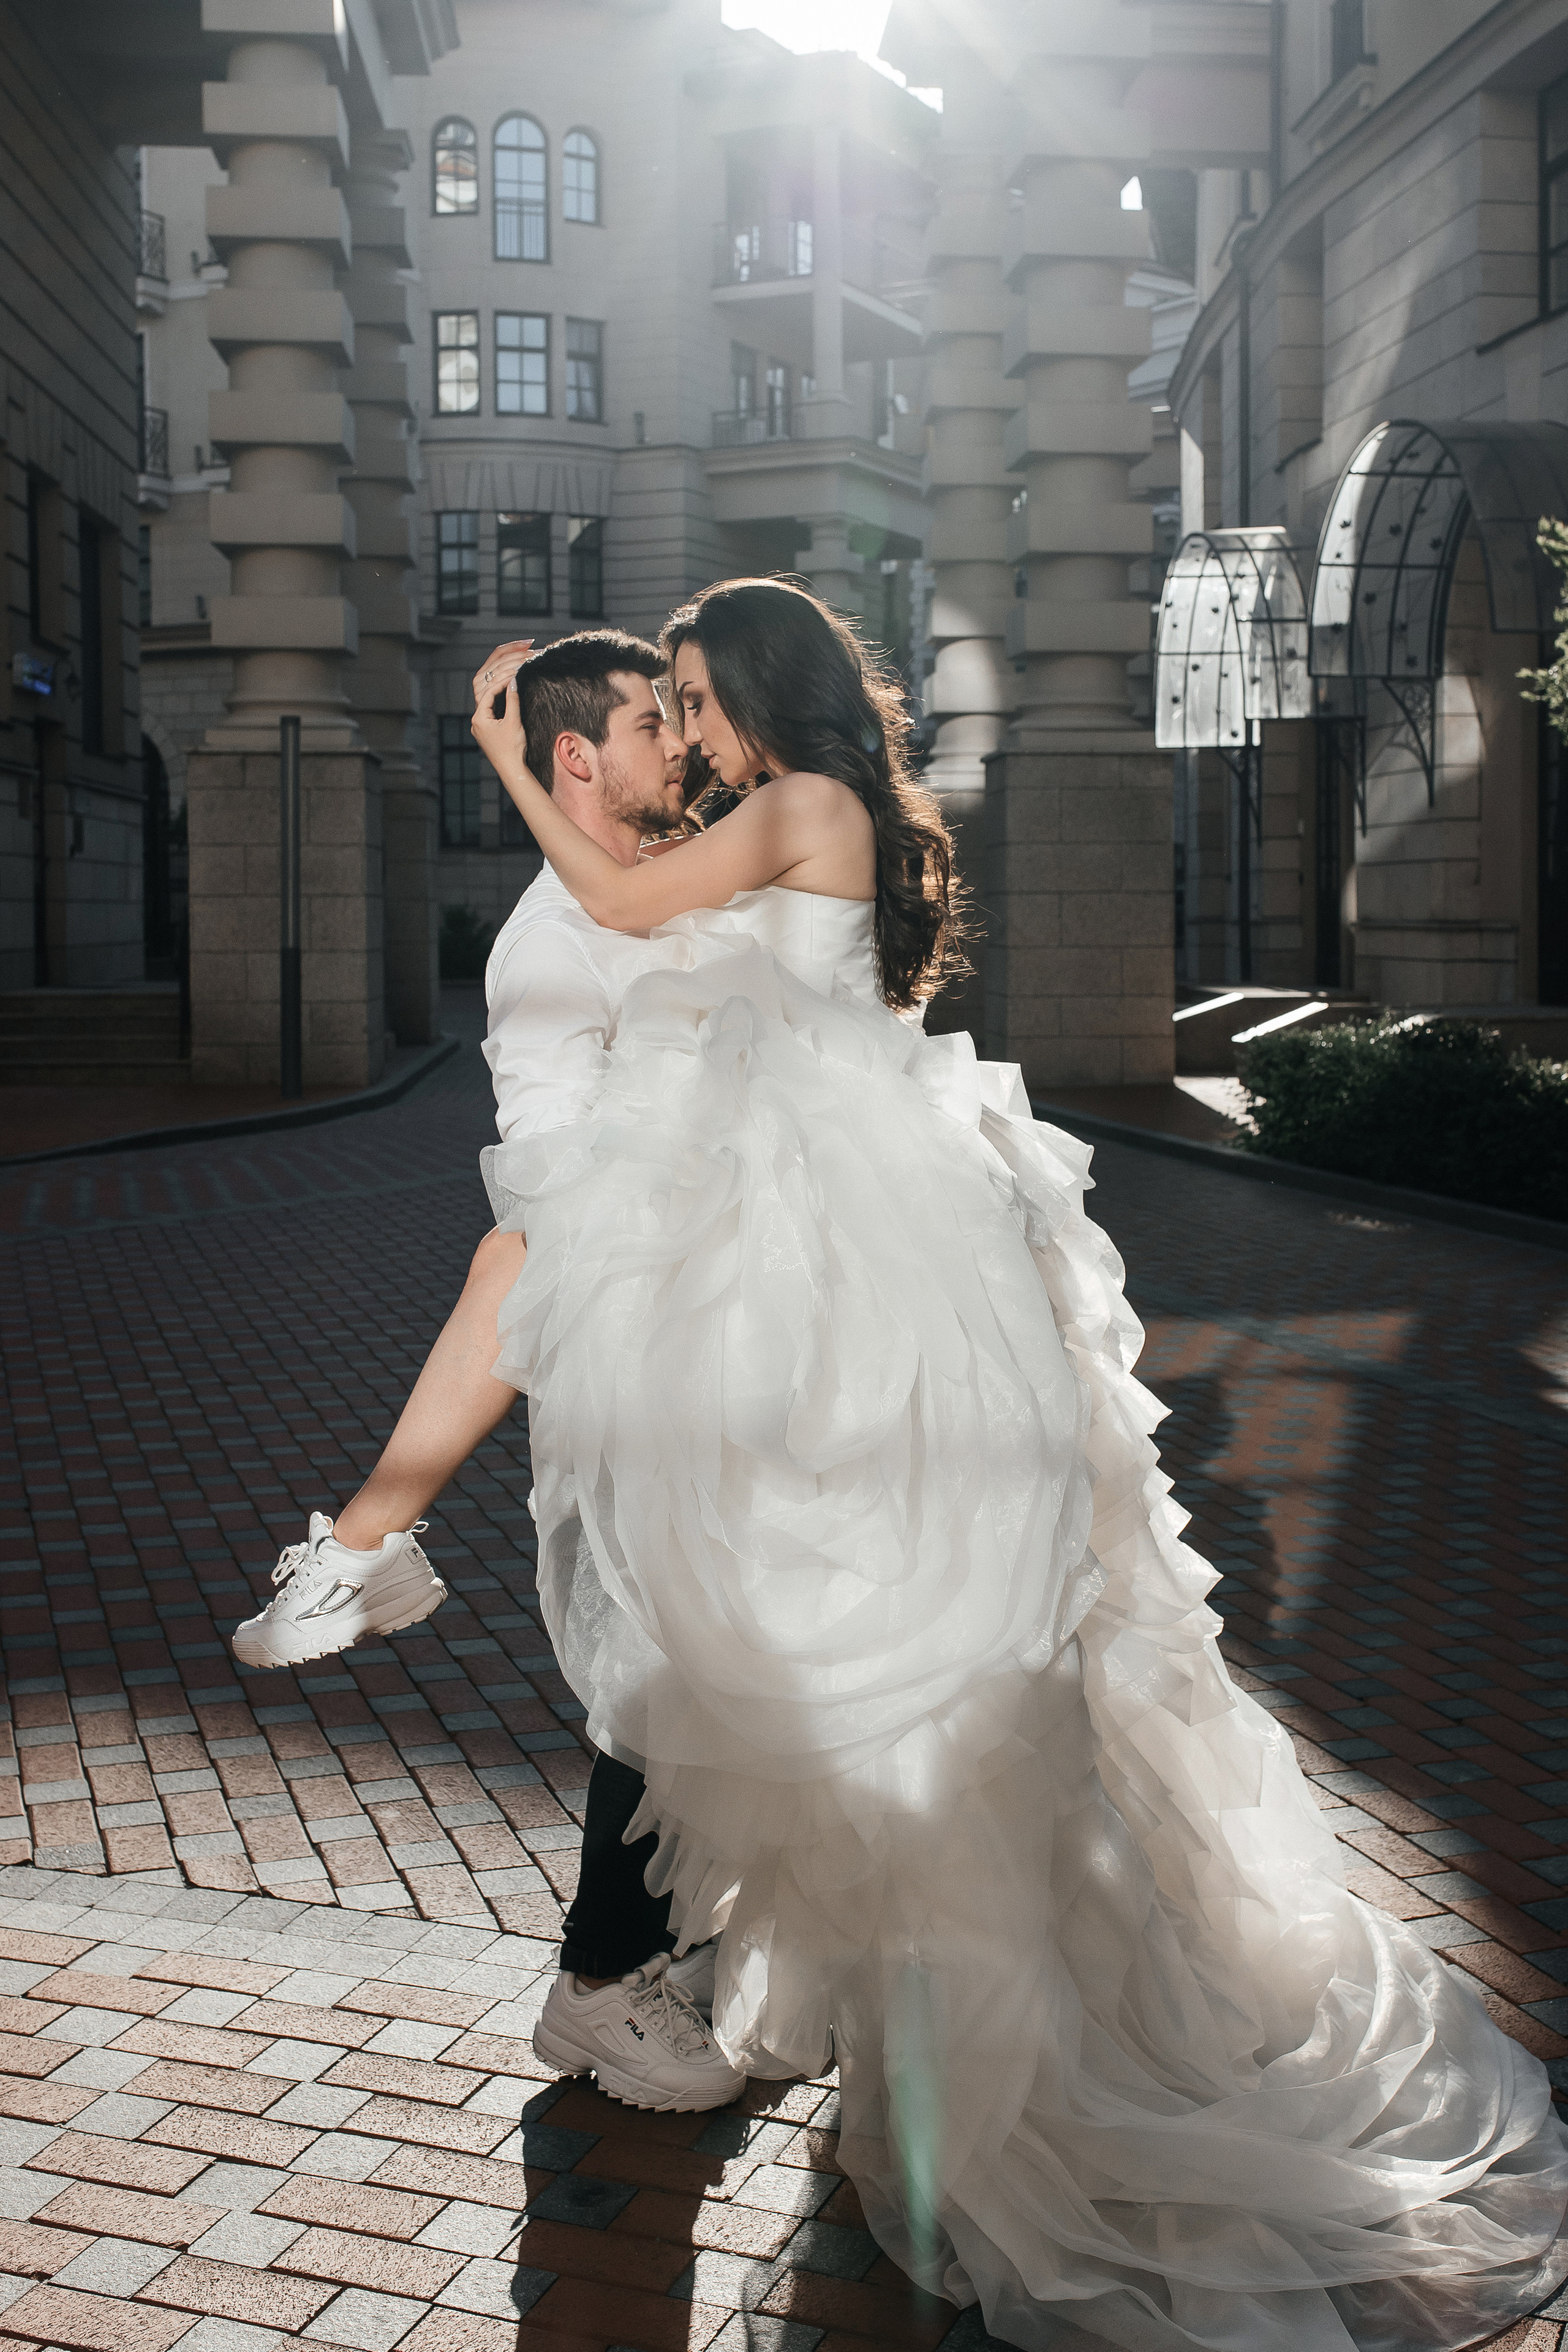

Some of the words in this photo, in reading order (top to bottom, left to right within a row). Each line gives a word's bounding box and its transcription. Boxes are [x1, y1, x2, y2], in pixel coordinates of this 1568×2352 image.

[299, 1580, 323, 1600] FILA
[292, 1632, 336, 1655] FILA
[625, 2018, 645, 2041] FILA
